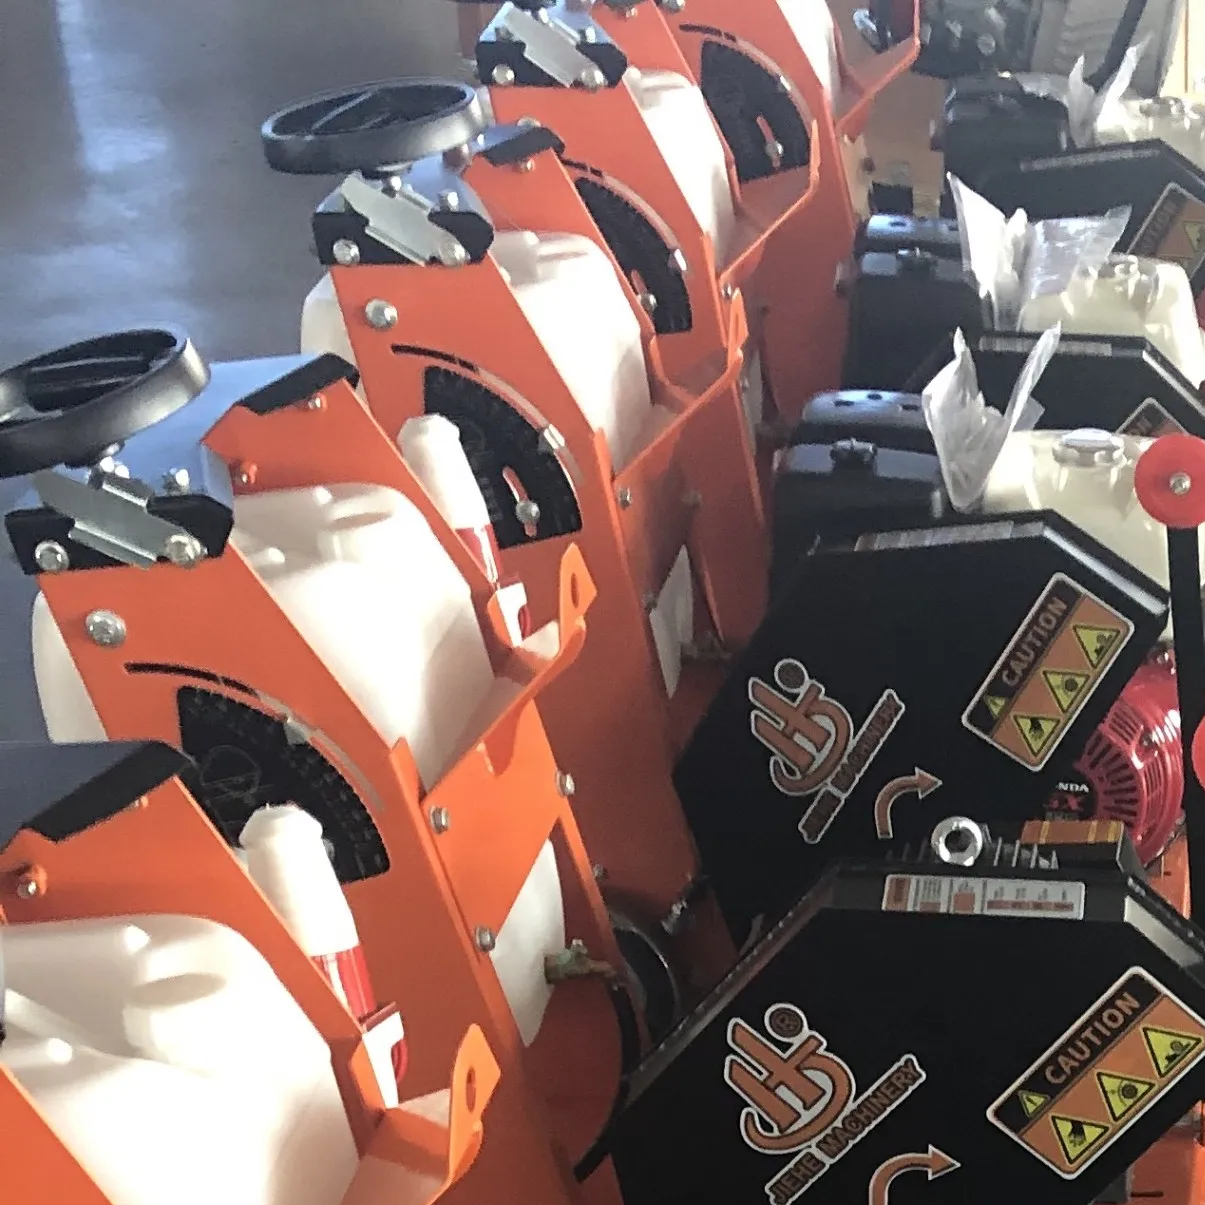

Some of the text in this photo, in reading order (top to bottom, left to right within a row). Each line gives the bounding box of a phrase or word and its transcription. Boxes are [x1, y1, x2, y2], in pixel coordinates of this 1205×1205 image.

[1002, 596, 1068, 686] CAUTION
[1056, 782, 1090, 793] NDA
[1044, 991, 1141, 1085] CAUTION
[767, 1057, 923, 1205] JIEHE MACHINERY
